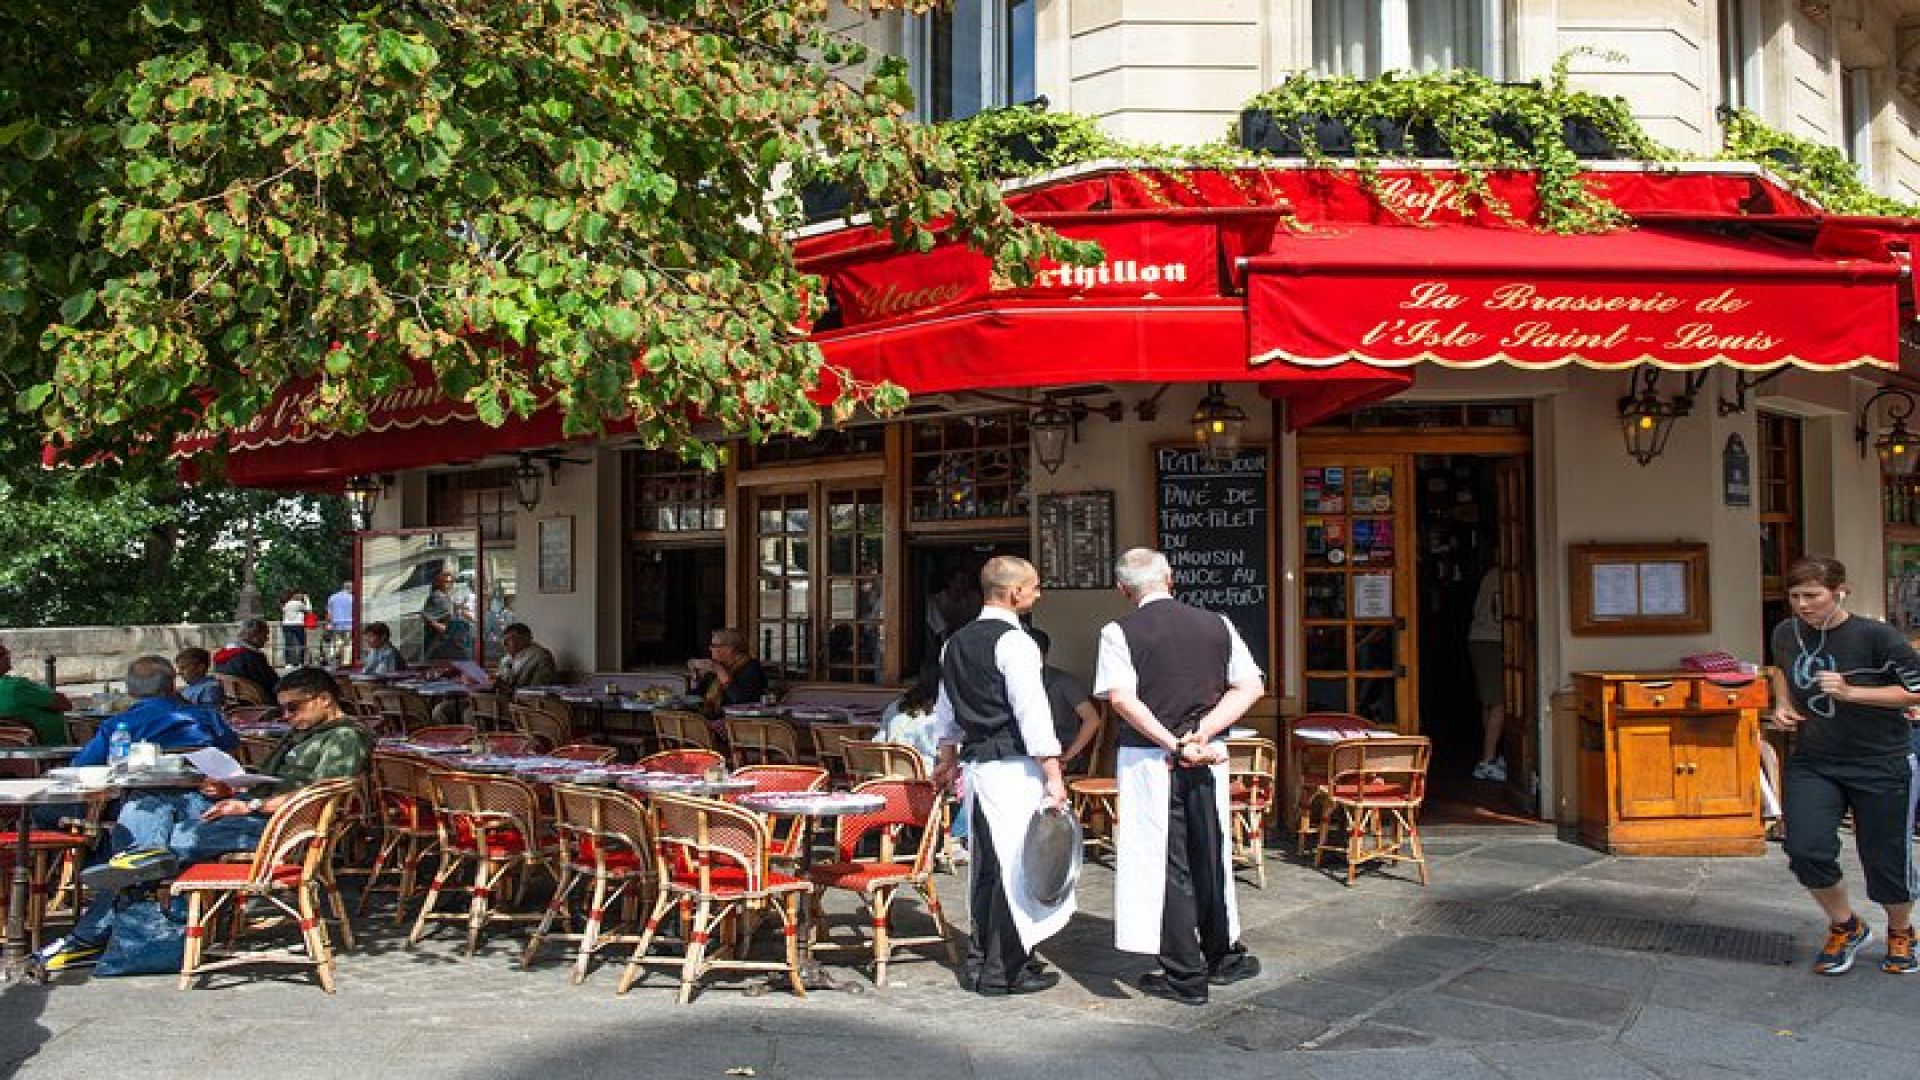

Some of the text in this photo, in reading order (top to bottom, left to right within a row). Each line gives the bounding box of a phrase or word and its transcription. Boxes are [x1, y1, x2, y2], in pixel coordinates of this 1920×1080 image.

[1034, 260, 1187, 289] rthillon
[1400, 282, 1752, 313] La Brasserie de
[1361, 319, 1486, 346] l'Isle
[1501, 321, 1630, 349] Saint
[1663, 321, 1785, 349] Louis
[1170, 549, 1244, 566] IMOUSIN
[1174, 568, 1222, 584] AUCE
[1173, 585, 1268, 607] OQUEFORT
